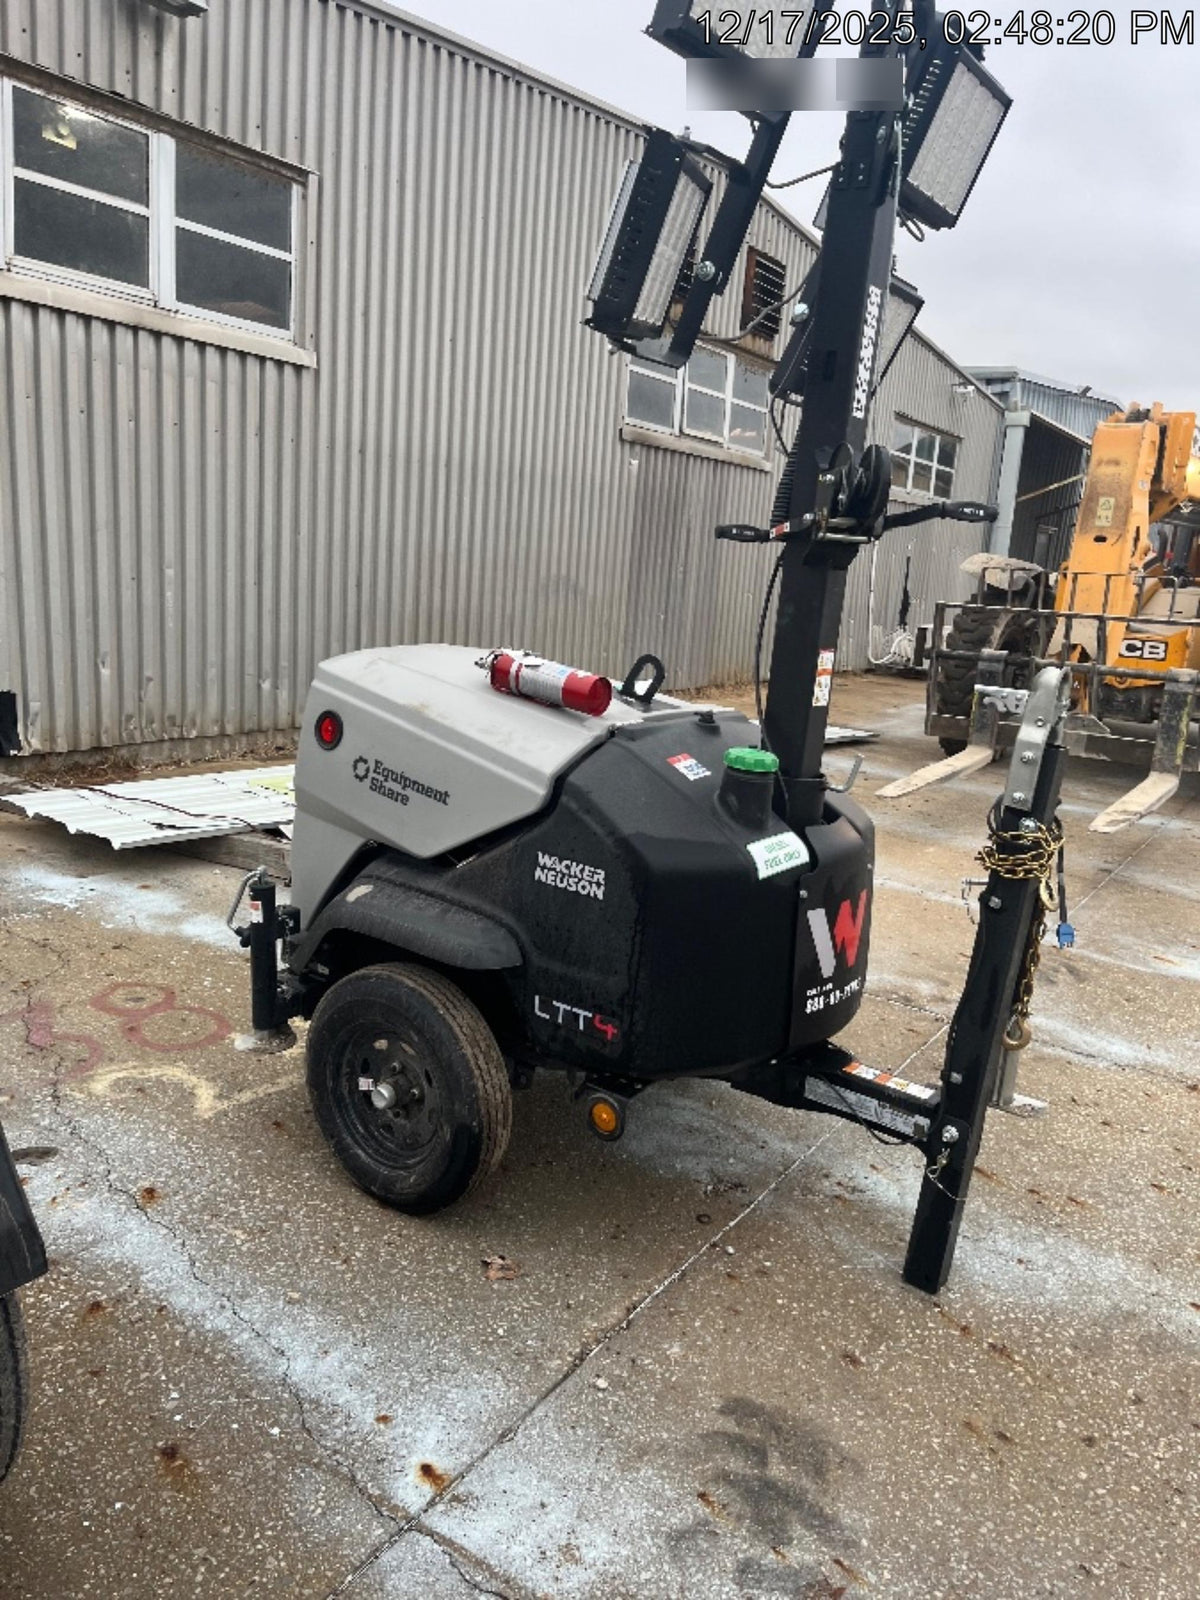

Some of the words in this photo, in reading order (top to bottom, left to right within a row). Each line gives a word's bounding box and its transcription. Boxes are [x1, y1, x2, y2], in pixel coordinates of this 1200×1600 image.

[1119, 639, 1167, 660] CB
[369, 776, 410, 806] Share
[373, 759, 450, 806] Equipment
[534, 866, 605, 901] NEUSON
[537, 850, 606, 885] WACKER
[534, 994, 618, 1042] LTT4
